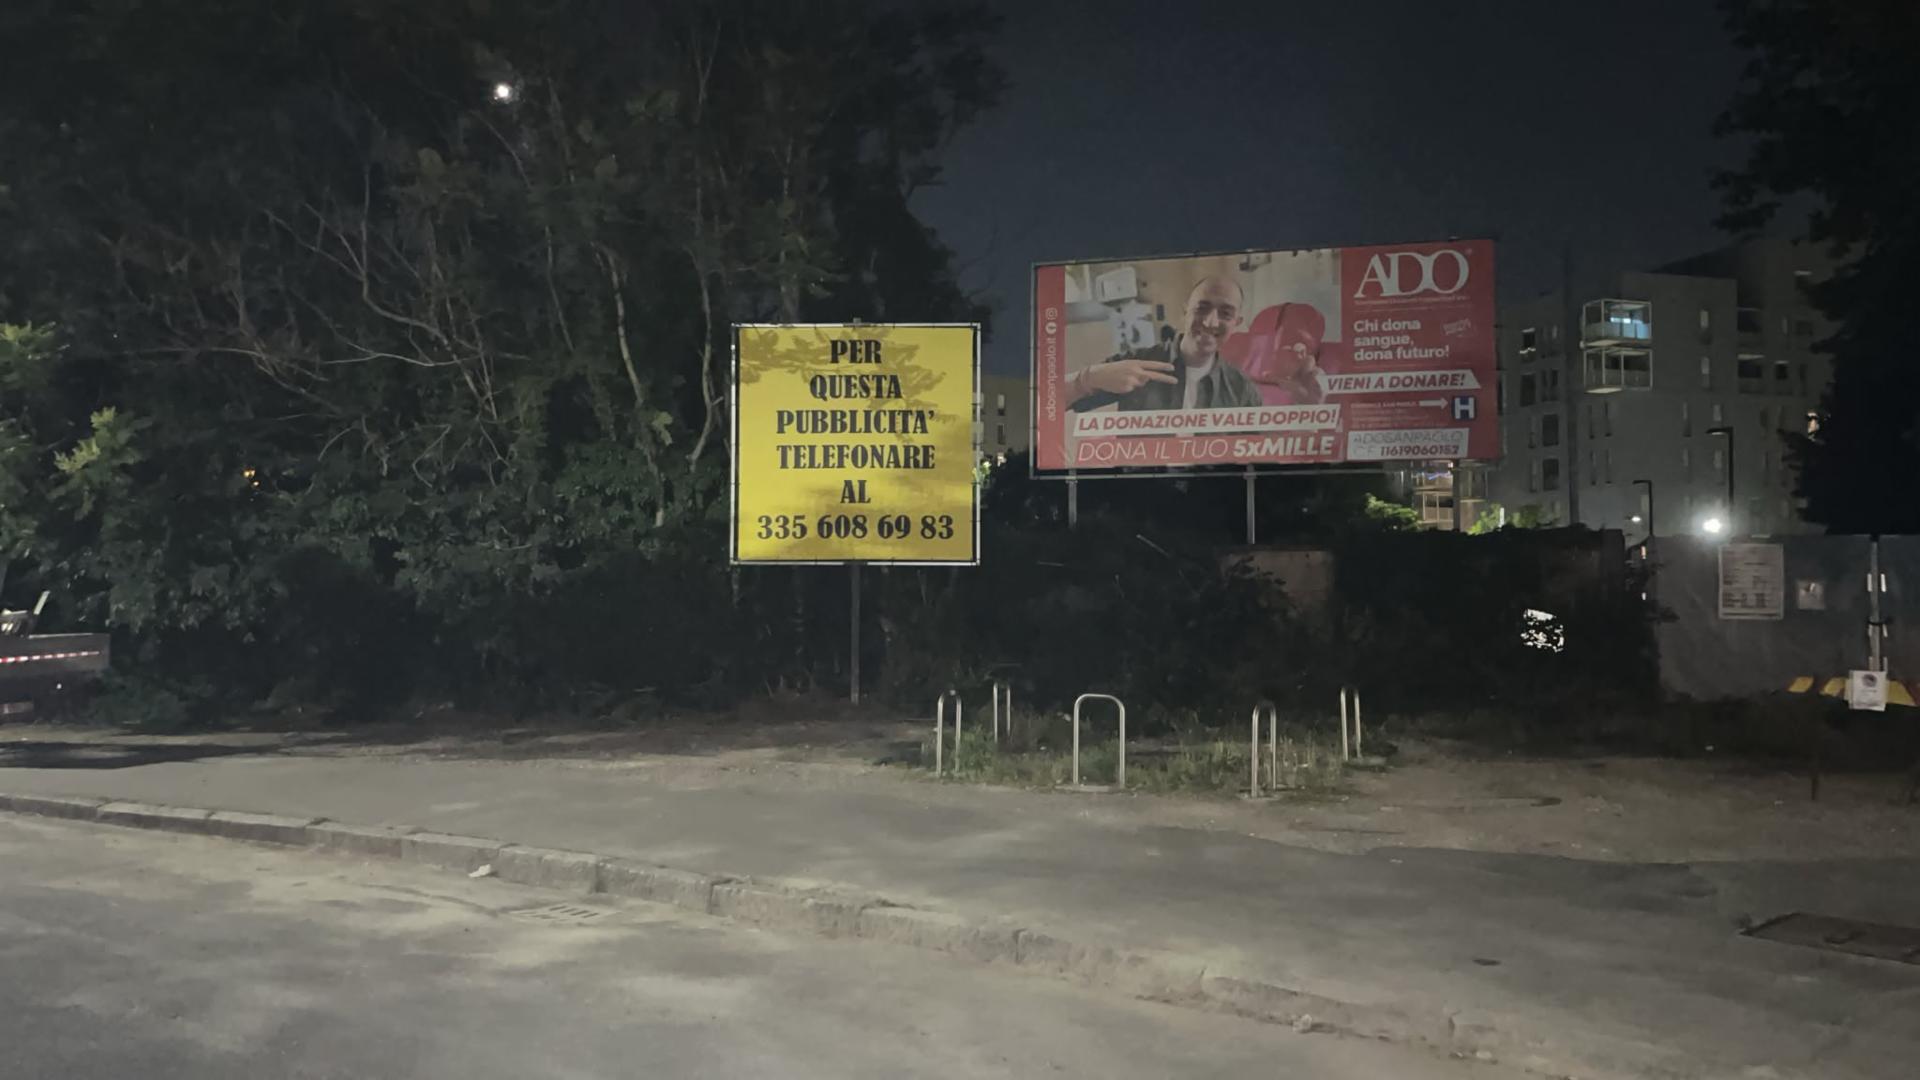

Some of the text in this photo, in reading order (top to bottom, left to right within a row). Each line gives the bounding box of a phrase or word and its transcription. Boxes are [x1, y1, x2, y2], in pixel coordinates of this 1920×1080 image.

[1354, 249, 1469, 297] ADO
[1354, 318, 1421, 332] Chi dona
[830, 339, 882, 364] PER
[1354, 335, 1414, 349] sangue,
[1354, 345, 1450, 361] dona futuro!
[809, 375, 903, 401] QUESTA
[1327, 373, 1466, 391] VIENI A DONARE!
[1079, 418, 1099, 431] LA
[1103, 413, 1207, 430] DONAZIONE
[1212, 411, 1256, 427] VALE
[1259, 409, 1337, 425] DOPPIO!
[1454, 397, 1475, 420] H
[776, 409, 935, 434] PUBBLICITA'
[1078, 435, 1335, 462] DONA IL TUO 5xMILLE
[1353, 431, 1464, 445] ADOSANPAOLO
[777, 445, 936, 470] TELEFONARE
[1380, 444, 1460, 457] 11619060152
[840, 480, 872, 504] AL
[757, 515, 954, 540] 335 608 69 83
